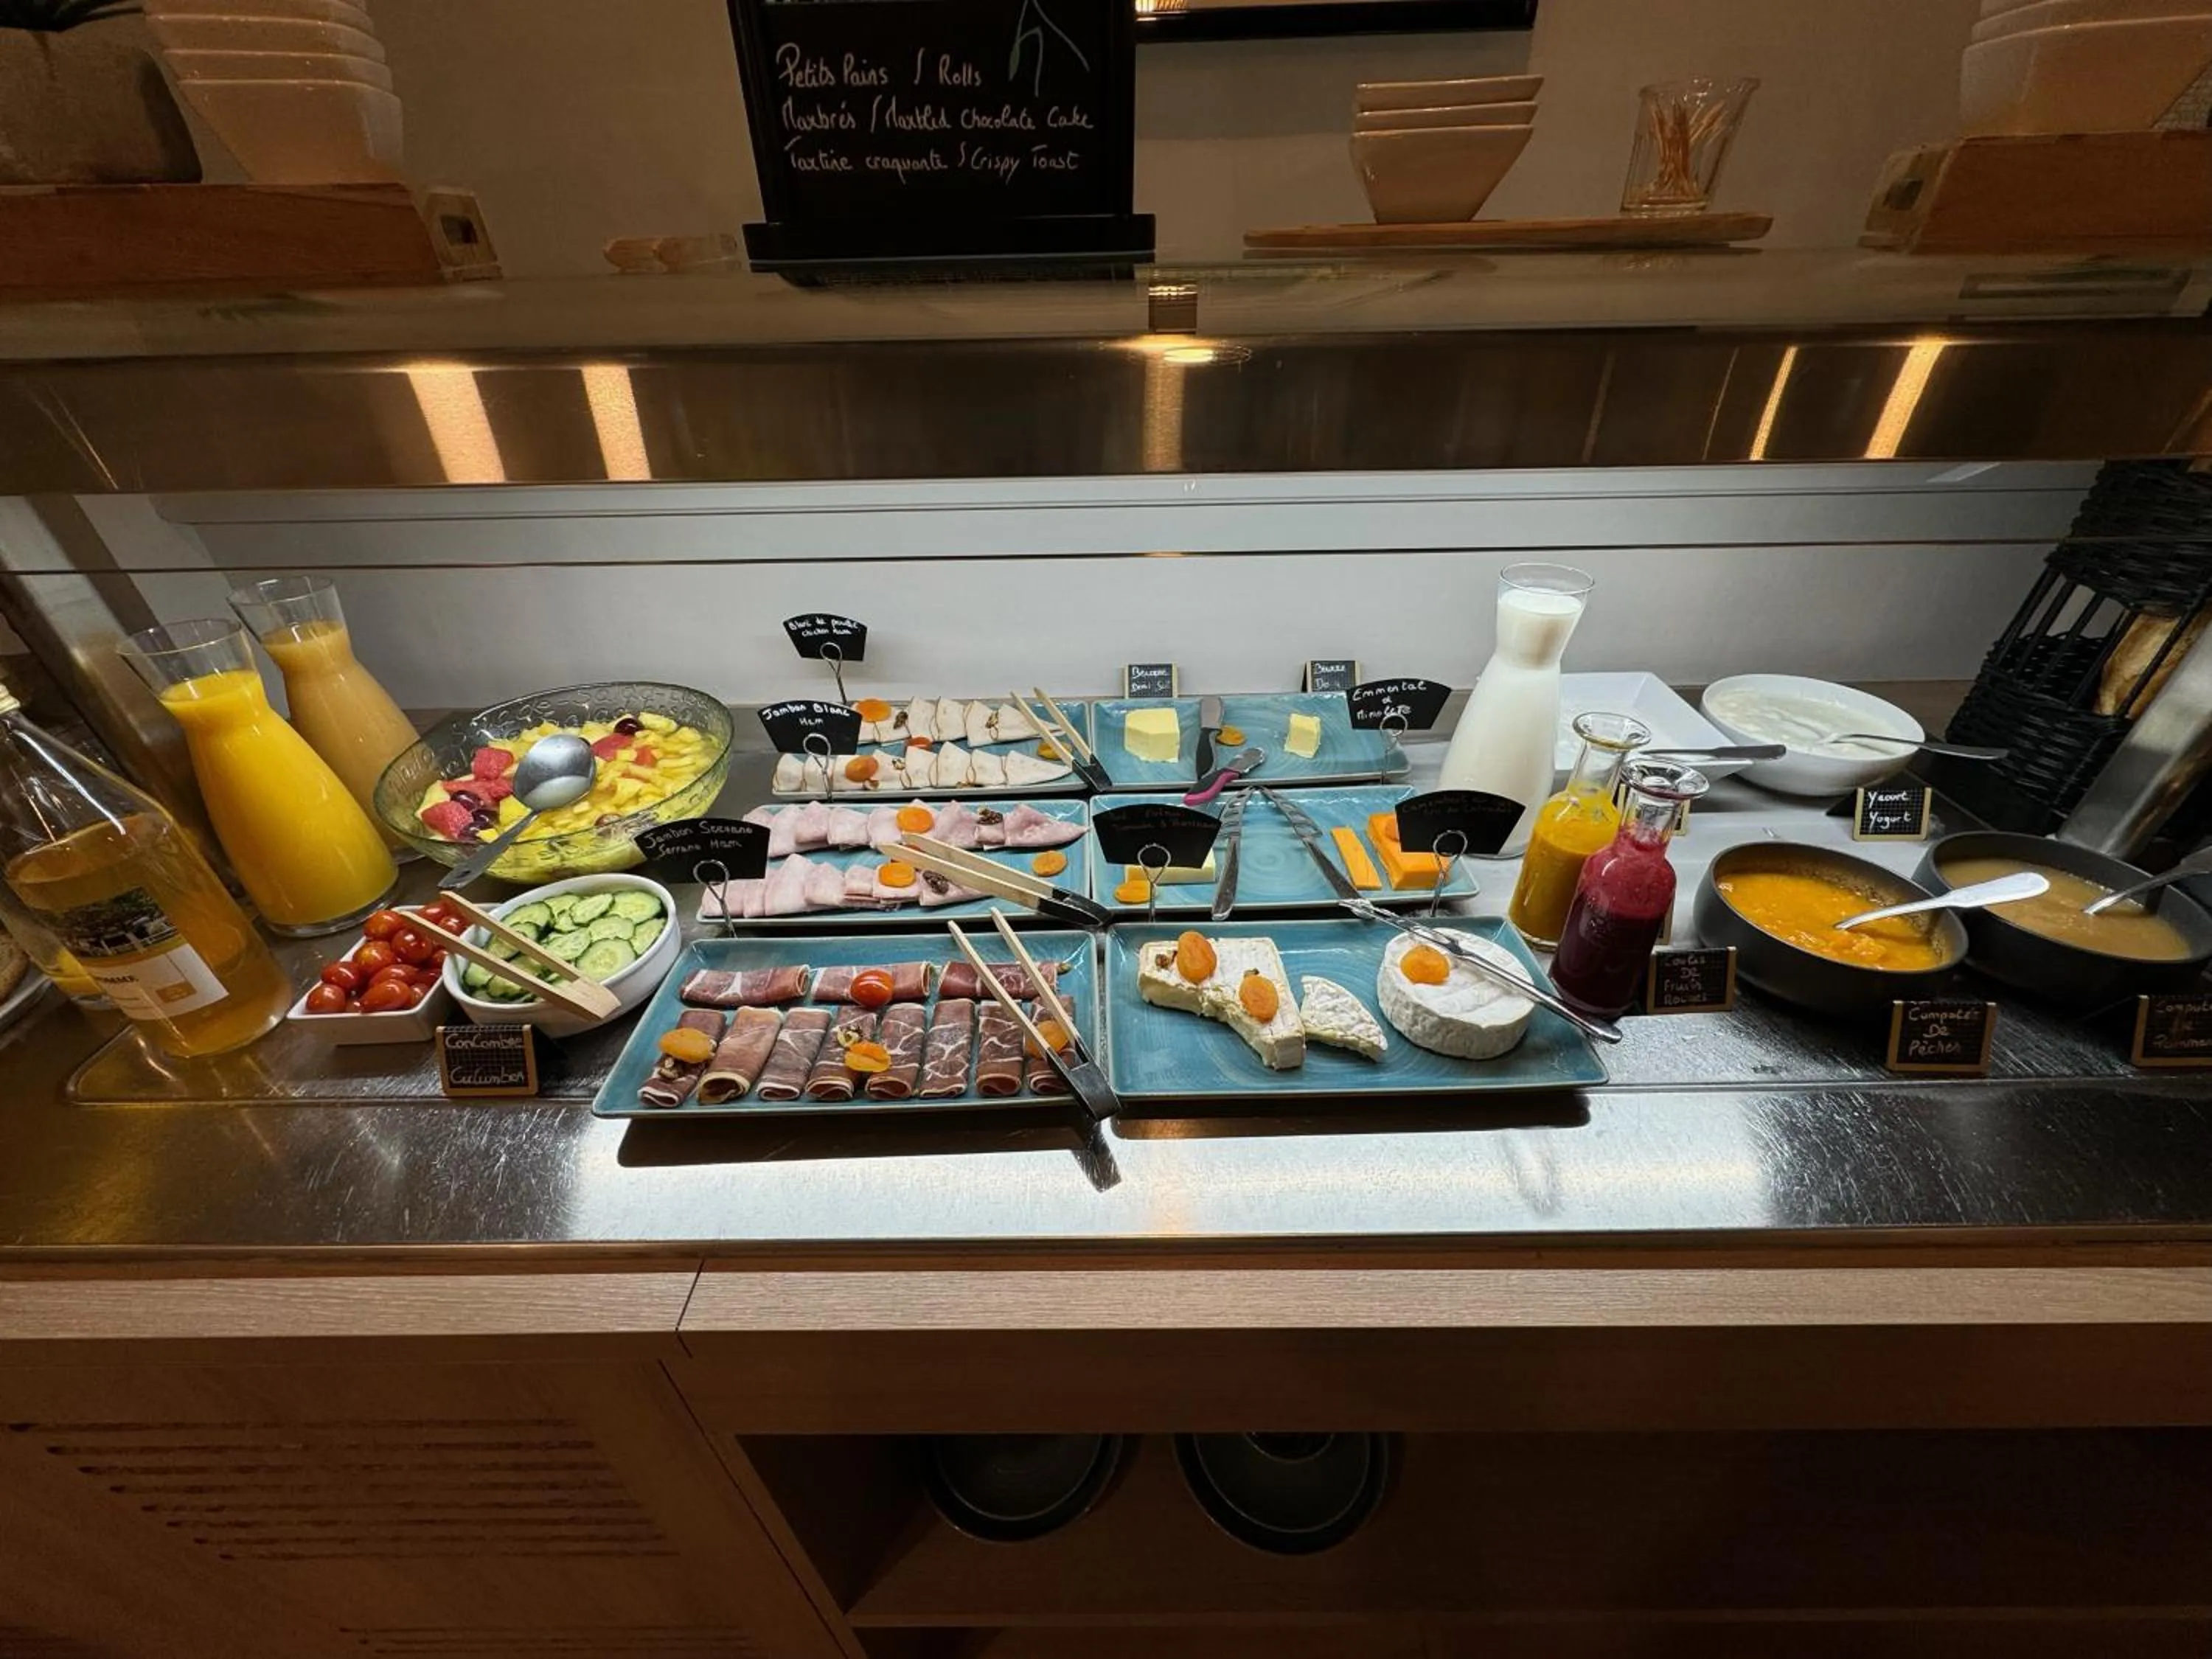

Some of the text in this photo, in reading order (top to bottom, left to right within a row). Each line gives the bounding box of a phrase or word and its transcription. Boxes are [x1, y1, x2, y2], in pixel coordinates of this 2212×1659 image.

[775, 41, 836, 88] Petits
[842, 52, 890, 87] Pains
[937, 53, 981, 87] Rolls
[960, 103, 1036, 131] Chocolate
[1046, 104, 1095, 130] Cake
[783, 135, 854, 171] Tartine
[865, 147, 949, 186] craquante
[970, 145, 1020, 186] Crispy
[1030, 143, 1081, 170] Toast
[1352, 681, 1427, 701] Emmental
[813, 702, 851, 717] Blanc
[1867, 790, 1910, 809] Yaourt
[1868, 810, 1912, 833] Yogurt
